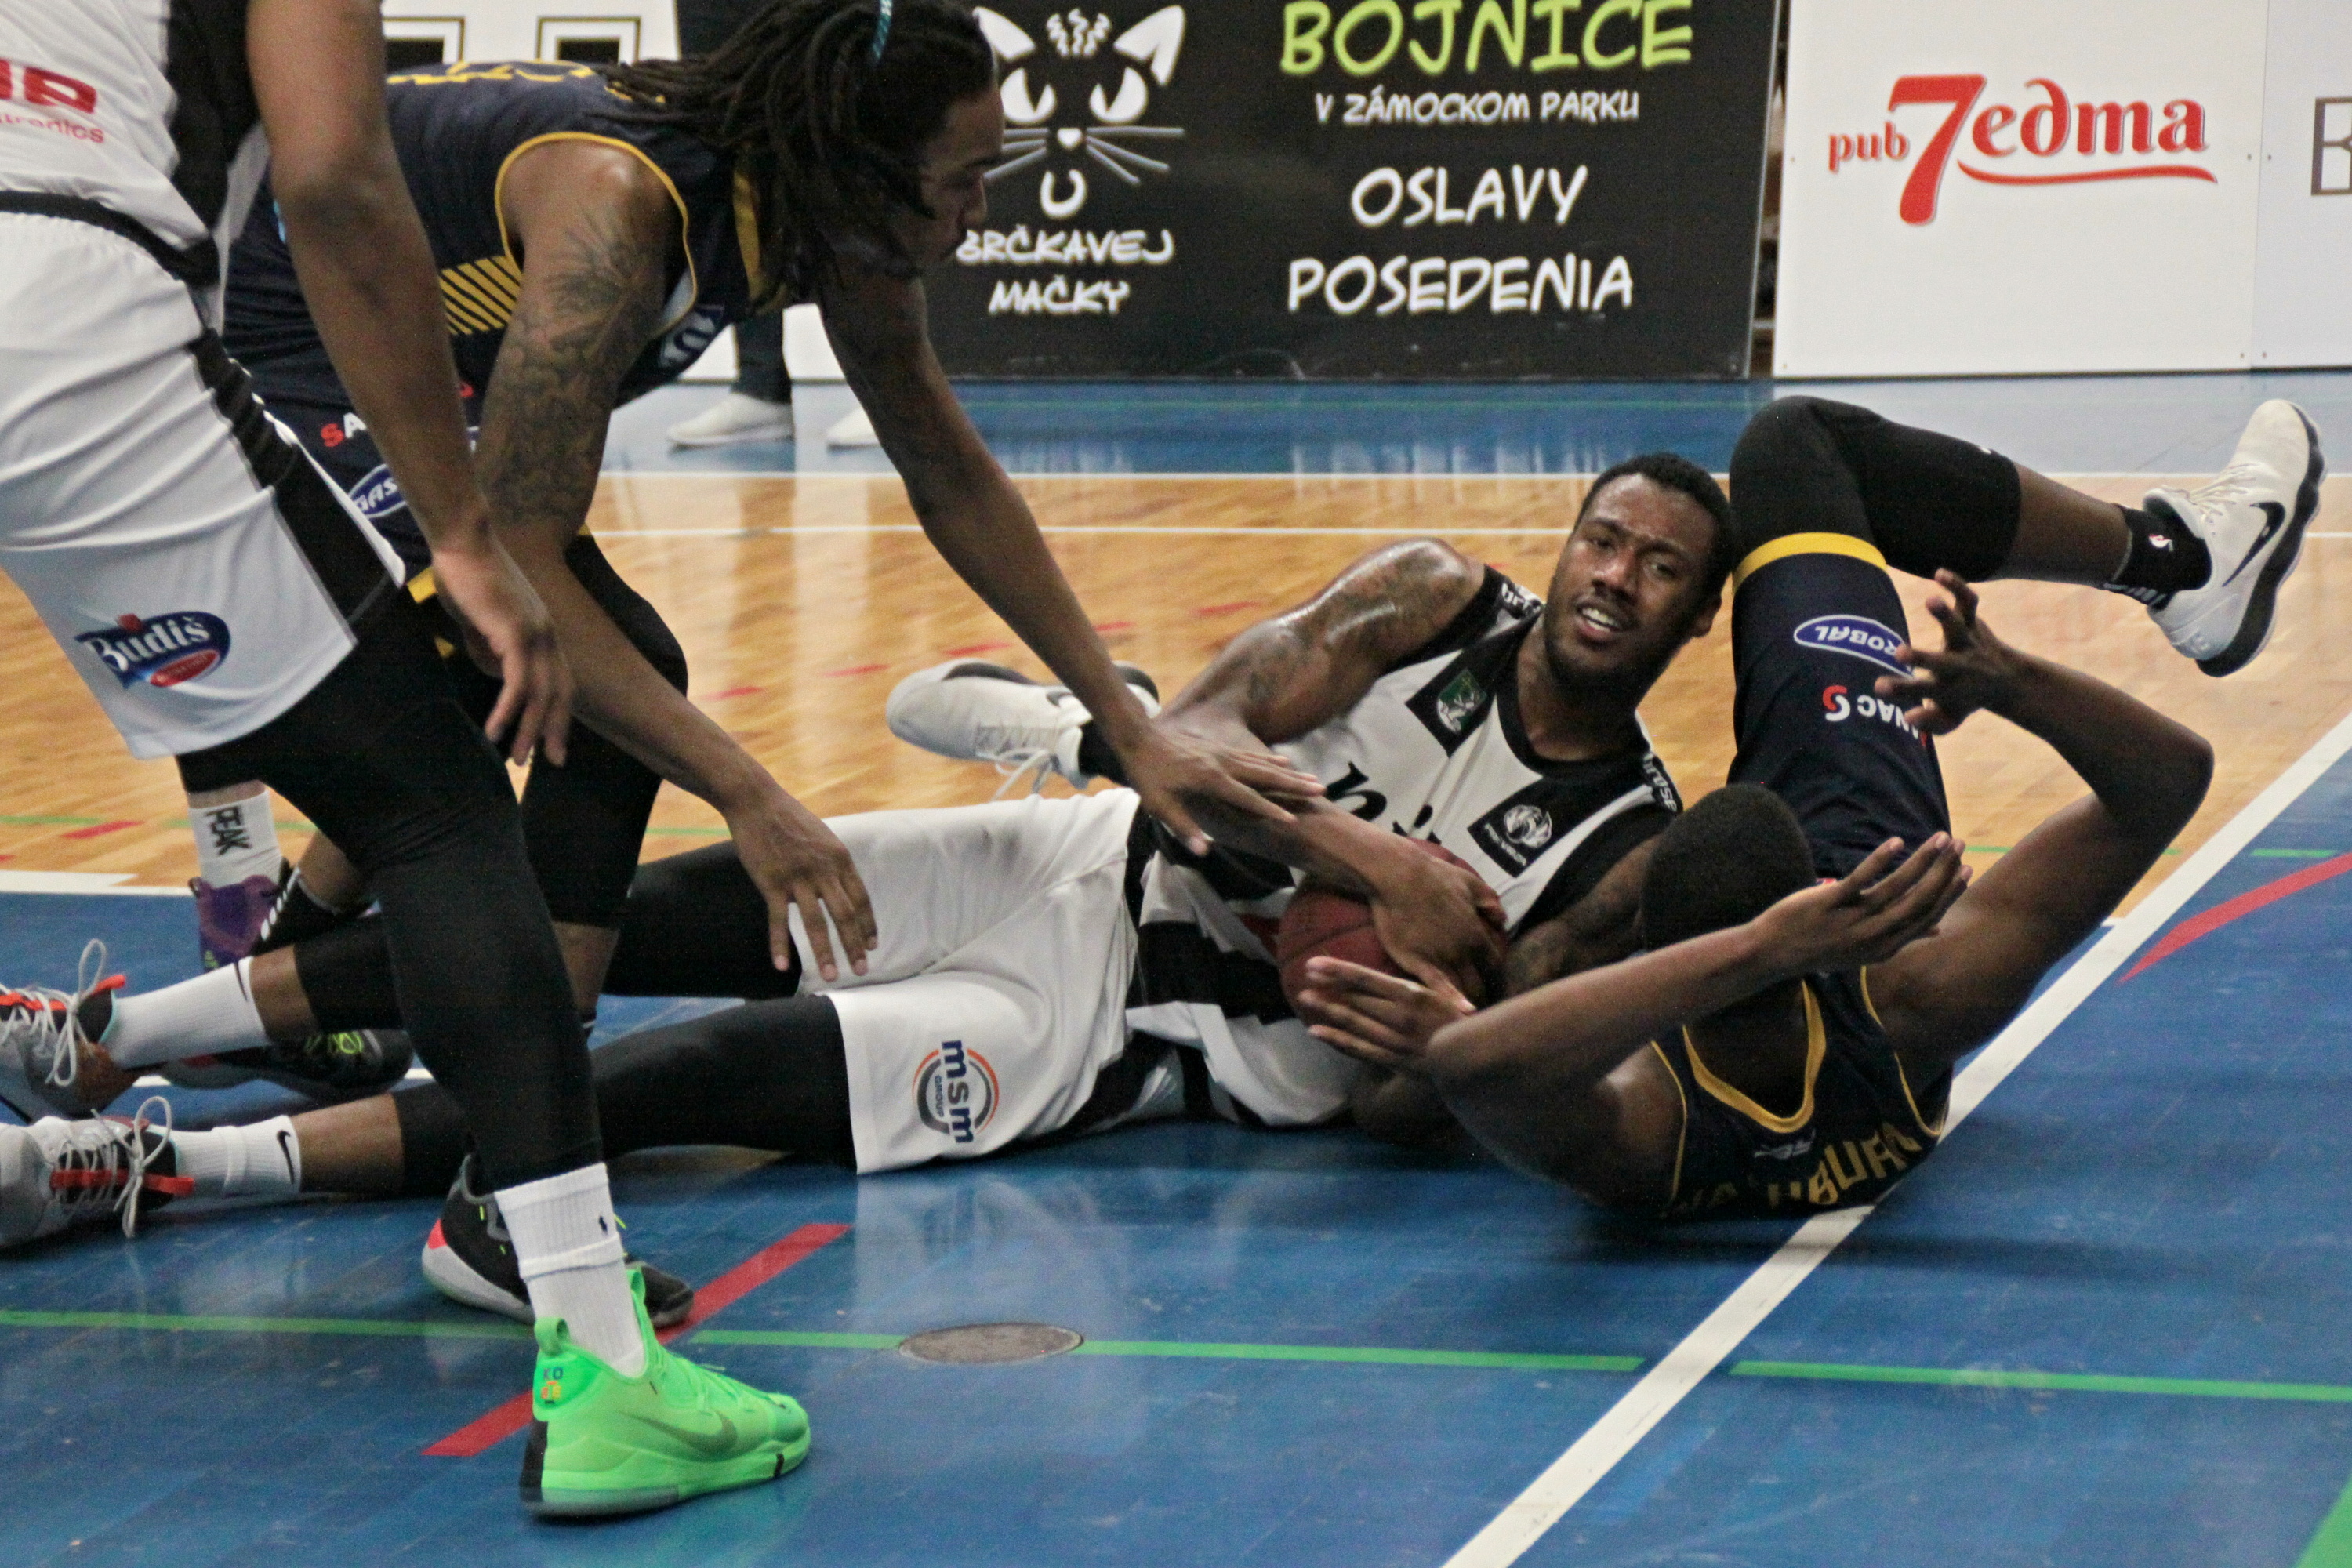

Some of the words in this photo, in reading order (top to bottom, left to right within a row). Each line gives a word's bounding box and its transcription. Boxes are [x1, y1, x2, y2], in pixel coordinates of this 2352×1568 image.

[1280, 0, 1693, 75] BOJNICE
[1316, 93, 1334, 122] V
[1342, 84, 1530, 124] ZÁMOCKOM
[1541, 90, 1639, 123] PARKU
[1828, 121, 1908, 173] pub
[1351, 165, 1588, 226] OSLAVY
[1288, 253, 1633, 314] POSEDENIA
[941, 1040, 975, 1143] msm
